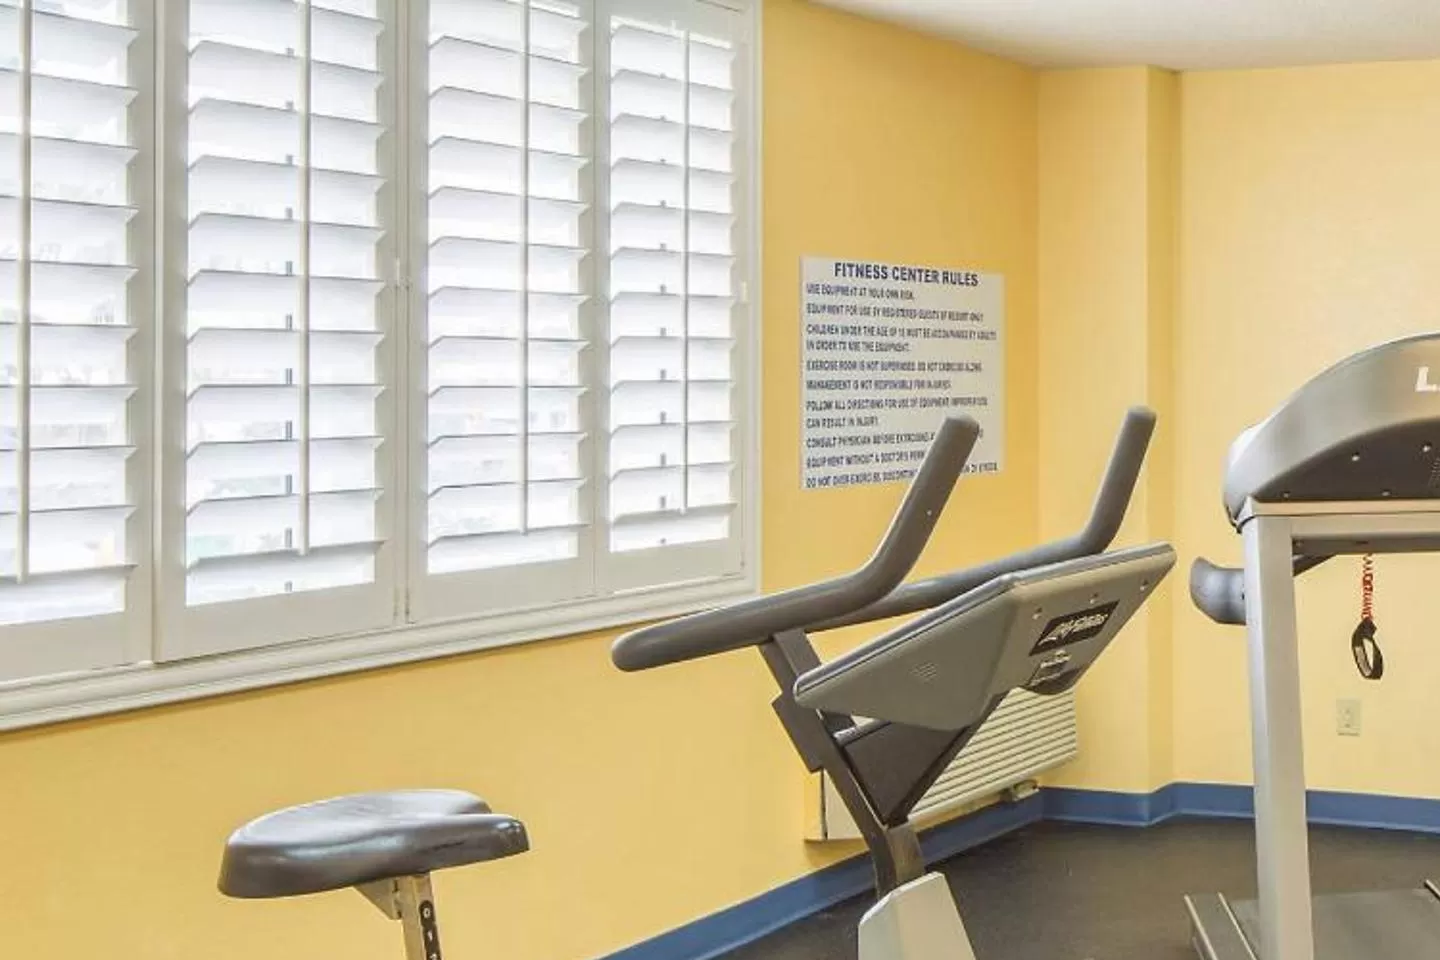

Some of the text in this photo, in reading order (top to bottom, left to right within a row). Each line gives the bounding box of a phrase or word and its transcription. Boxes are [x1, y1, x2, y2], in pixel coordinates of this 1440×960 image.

[834, 262, 979, 287] FITNESS CENTER RULES
[821, 284, 857, 297] EQUIPMENT
[860, 287, 867, 297] AT
[869, 288, 884, 299] YOUR
[886, 289, 899, 299] OWN
[807, 303, 844, 315] EQUIPMENT
[845, 305, 857, 316] FOR
[859, 306, 871, 317] USE
[873, 307, 881, 317] BY
[807, 324, 839, 336] CHILDREN
[840, 325, 861, 337] UNDER
[863, 326, 875, 337] THE
[876, 326, 889, 337] AGE
[807, 339, 814, 350] IN
[816, 340, 837, 351] ORDER
[807, 360, 838, 371] EXERCISE
[839, 360, 857, 371] ROOM
[866, 361, 879, 371] NOT
[807, 380, 851, 390] MANAGEMENT
[861, 380, 873, 390] NOT
[806, 400, 833, 411] FOLLOW
[847, 399, 884, 410] DIRECTIONS
[807, 418, 820, 429] CAN
[822, 417, 846, 428] RESULT
[848, 417, 854, 427] IN
[807, 436, 836, 448] CONSULT
[807, 456, 844, 469] EQUIPMENT
[845, 454, 874, 466] WITHOUT
